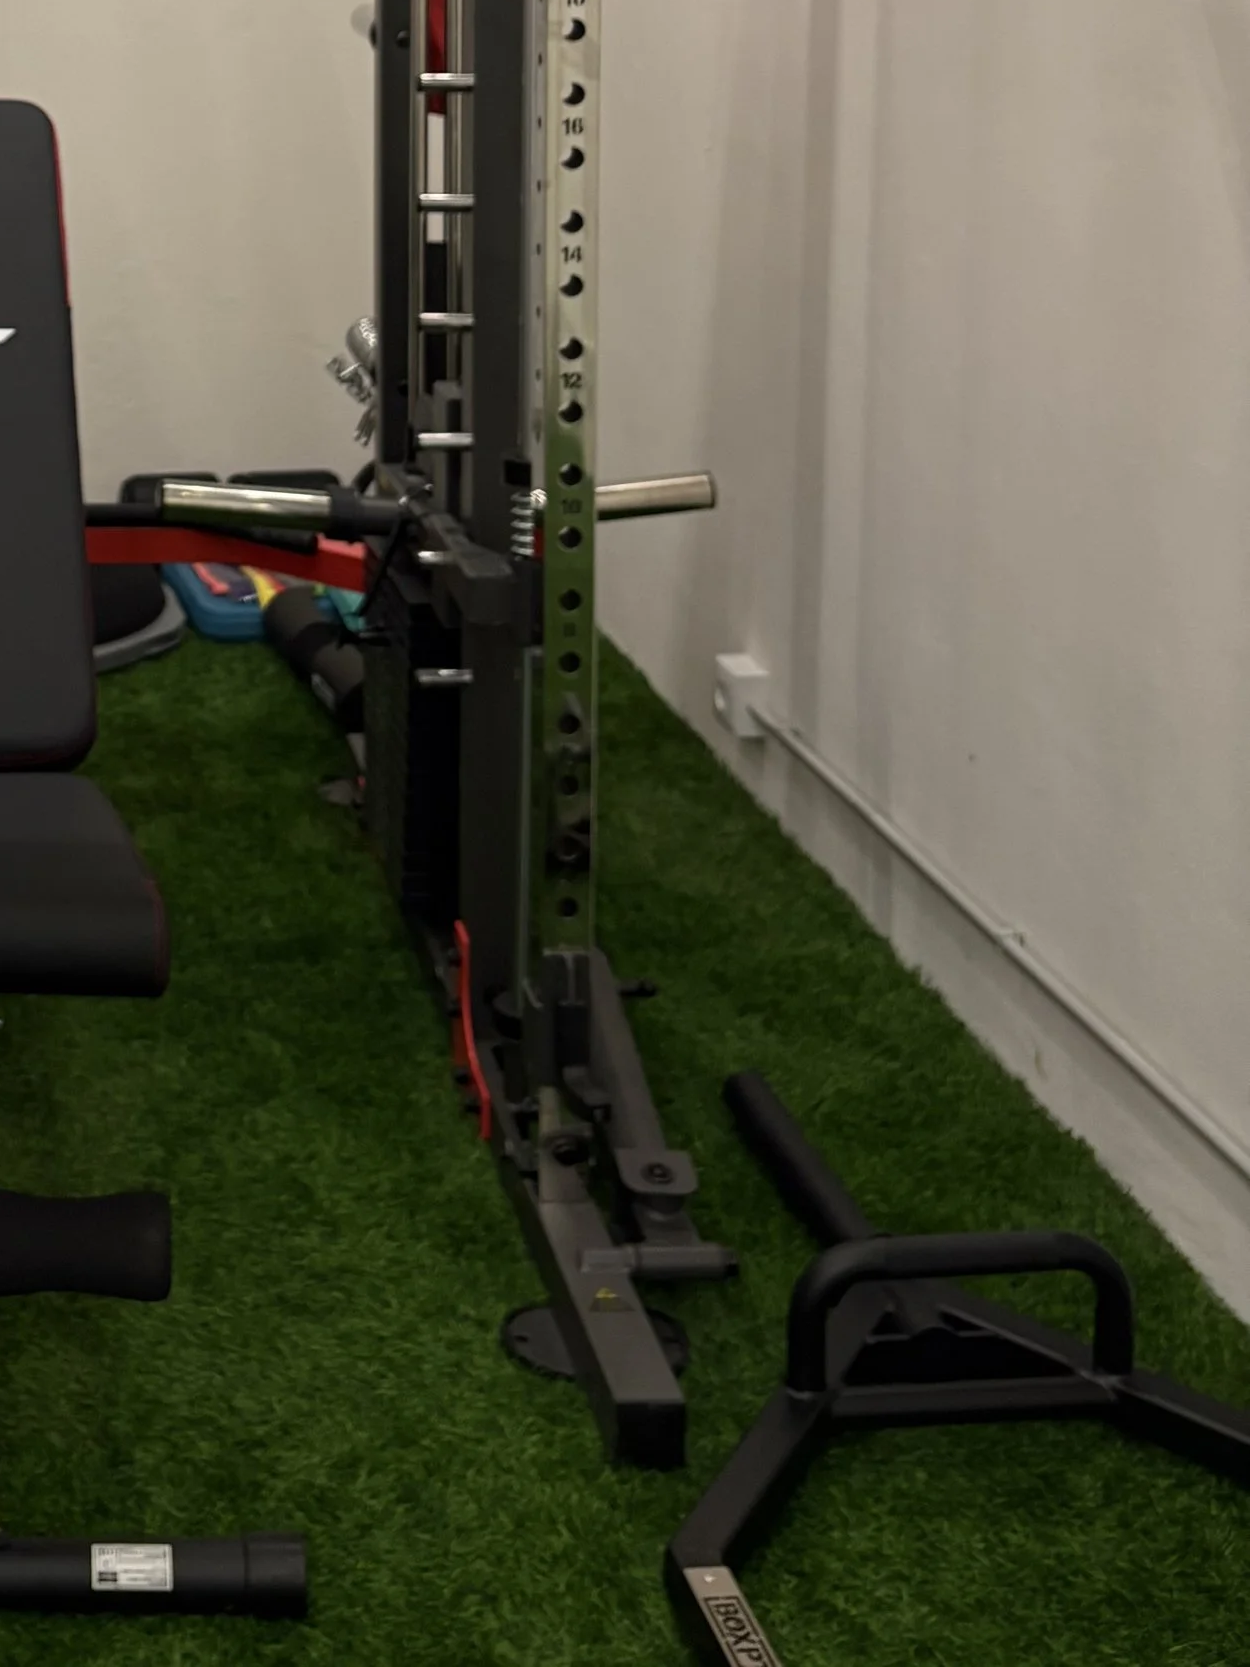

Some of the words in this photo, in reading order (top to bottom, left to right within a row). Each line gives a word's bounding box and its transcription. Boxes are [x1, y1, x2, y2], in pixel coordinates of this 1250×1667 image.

[561, 117, 584, 135] 16
[561, 246, 582, 264] 14
[560, 372, 582, 389] 12
